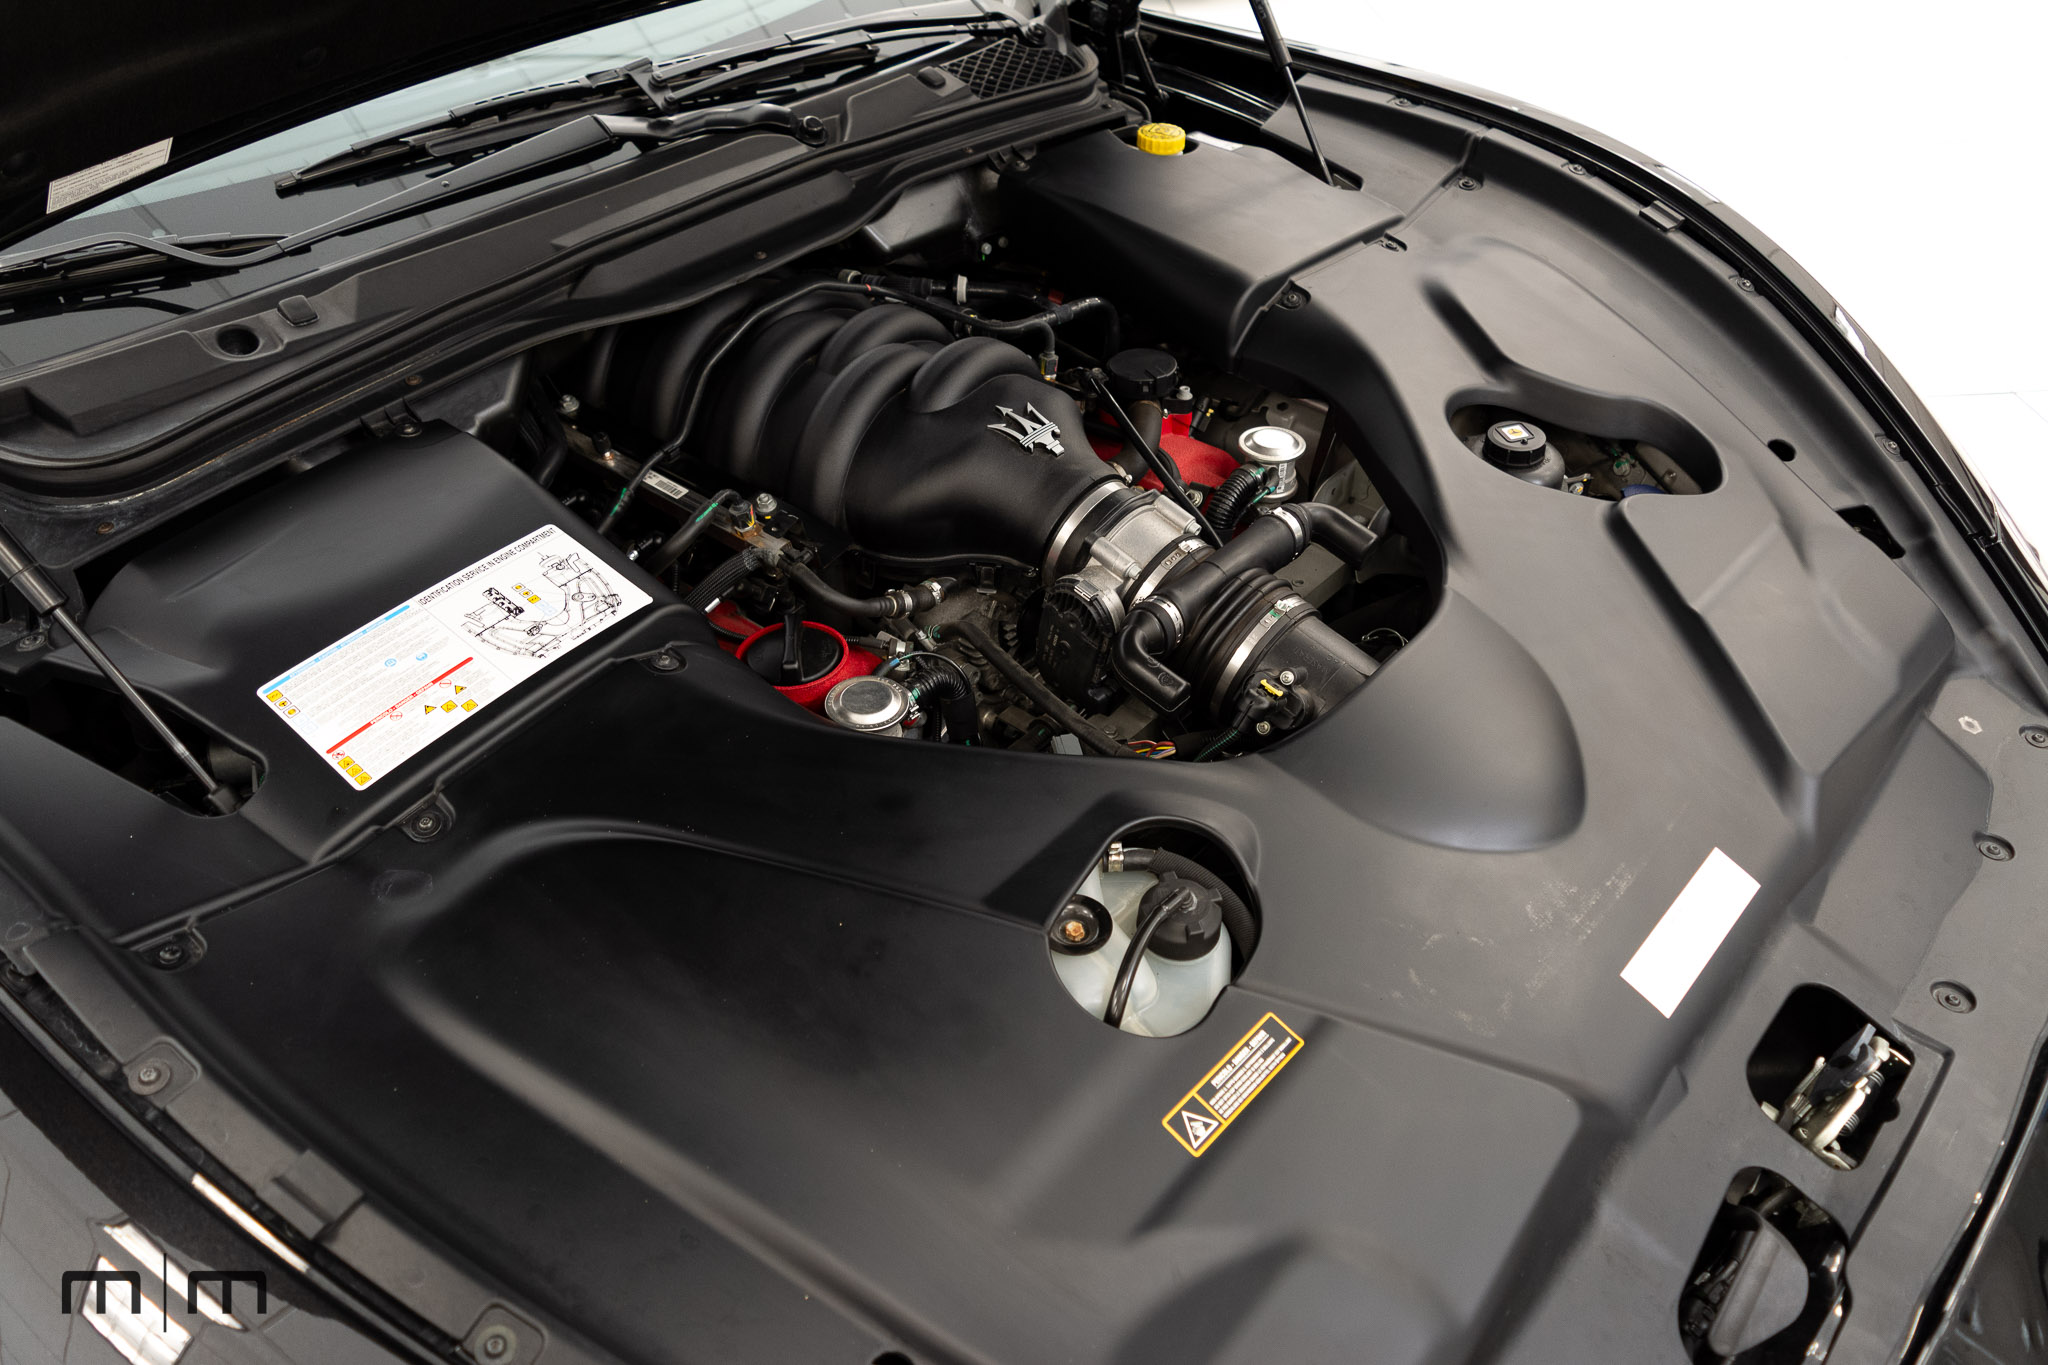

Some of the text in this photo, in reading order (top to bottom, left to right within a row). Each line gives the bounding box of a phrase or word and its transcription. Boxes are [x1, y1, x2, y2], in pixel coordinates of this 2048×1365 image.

[418, 527, 557, 606] IDENTIFICATION SERVICE IN ENGINE COMPARTMENT
